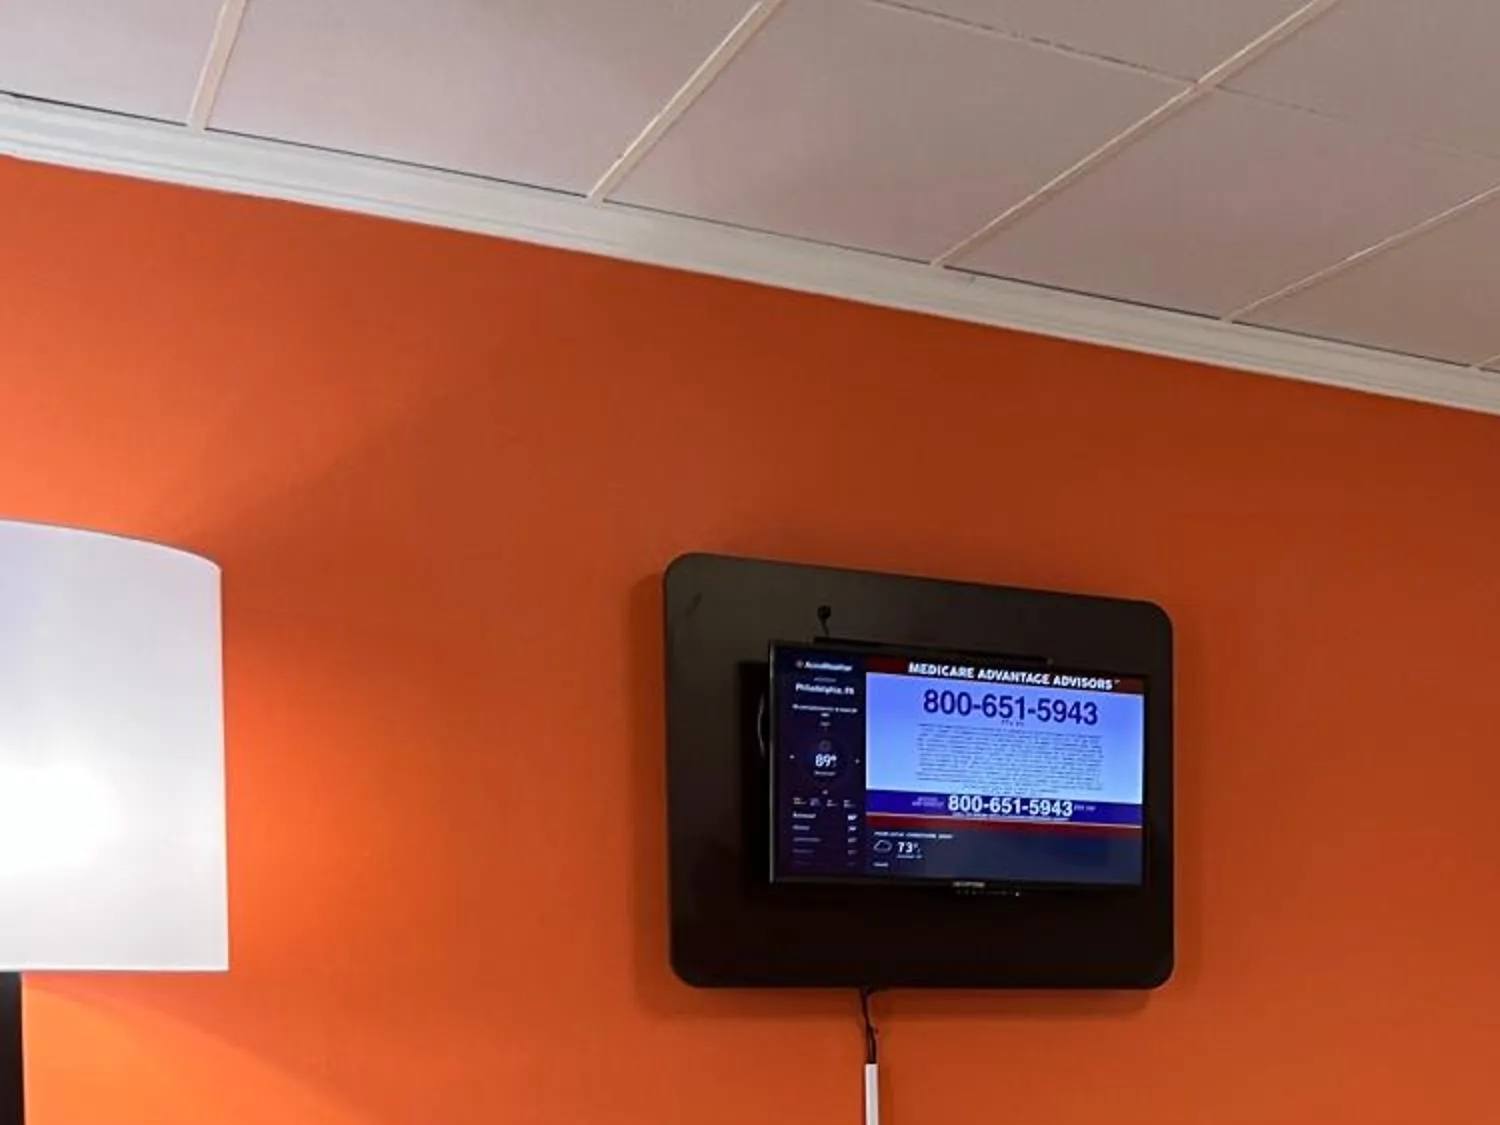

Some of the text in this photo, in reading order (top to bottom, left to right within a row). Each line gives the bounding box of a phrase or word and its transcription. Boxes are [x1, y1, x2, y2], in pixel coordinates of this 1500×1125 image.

[908, 661, 975, 678] MEDICARE
[977, 669, 1050, 685] ADVANTAGE
[923, 689, 1099, 726] 800-651-5943
[948, 794, 1074, 818] 800-651-5943
